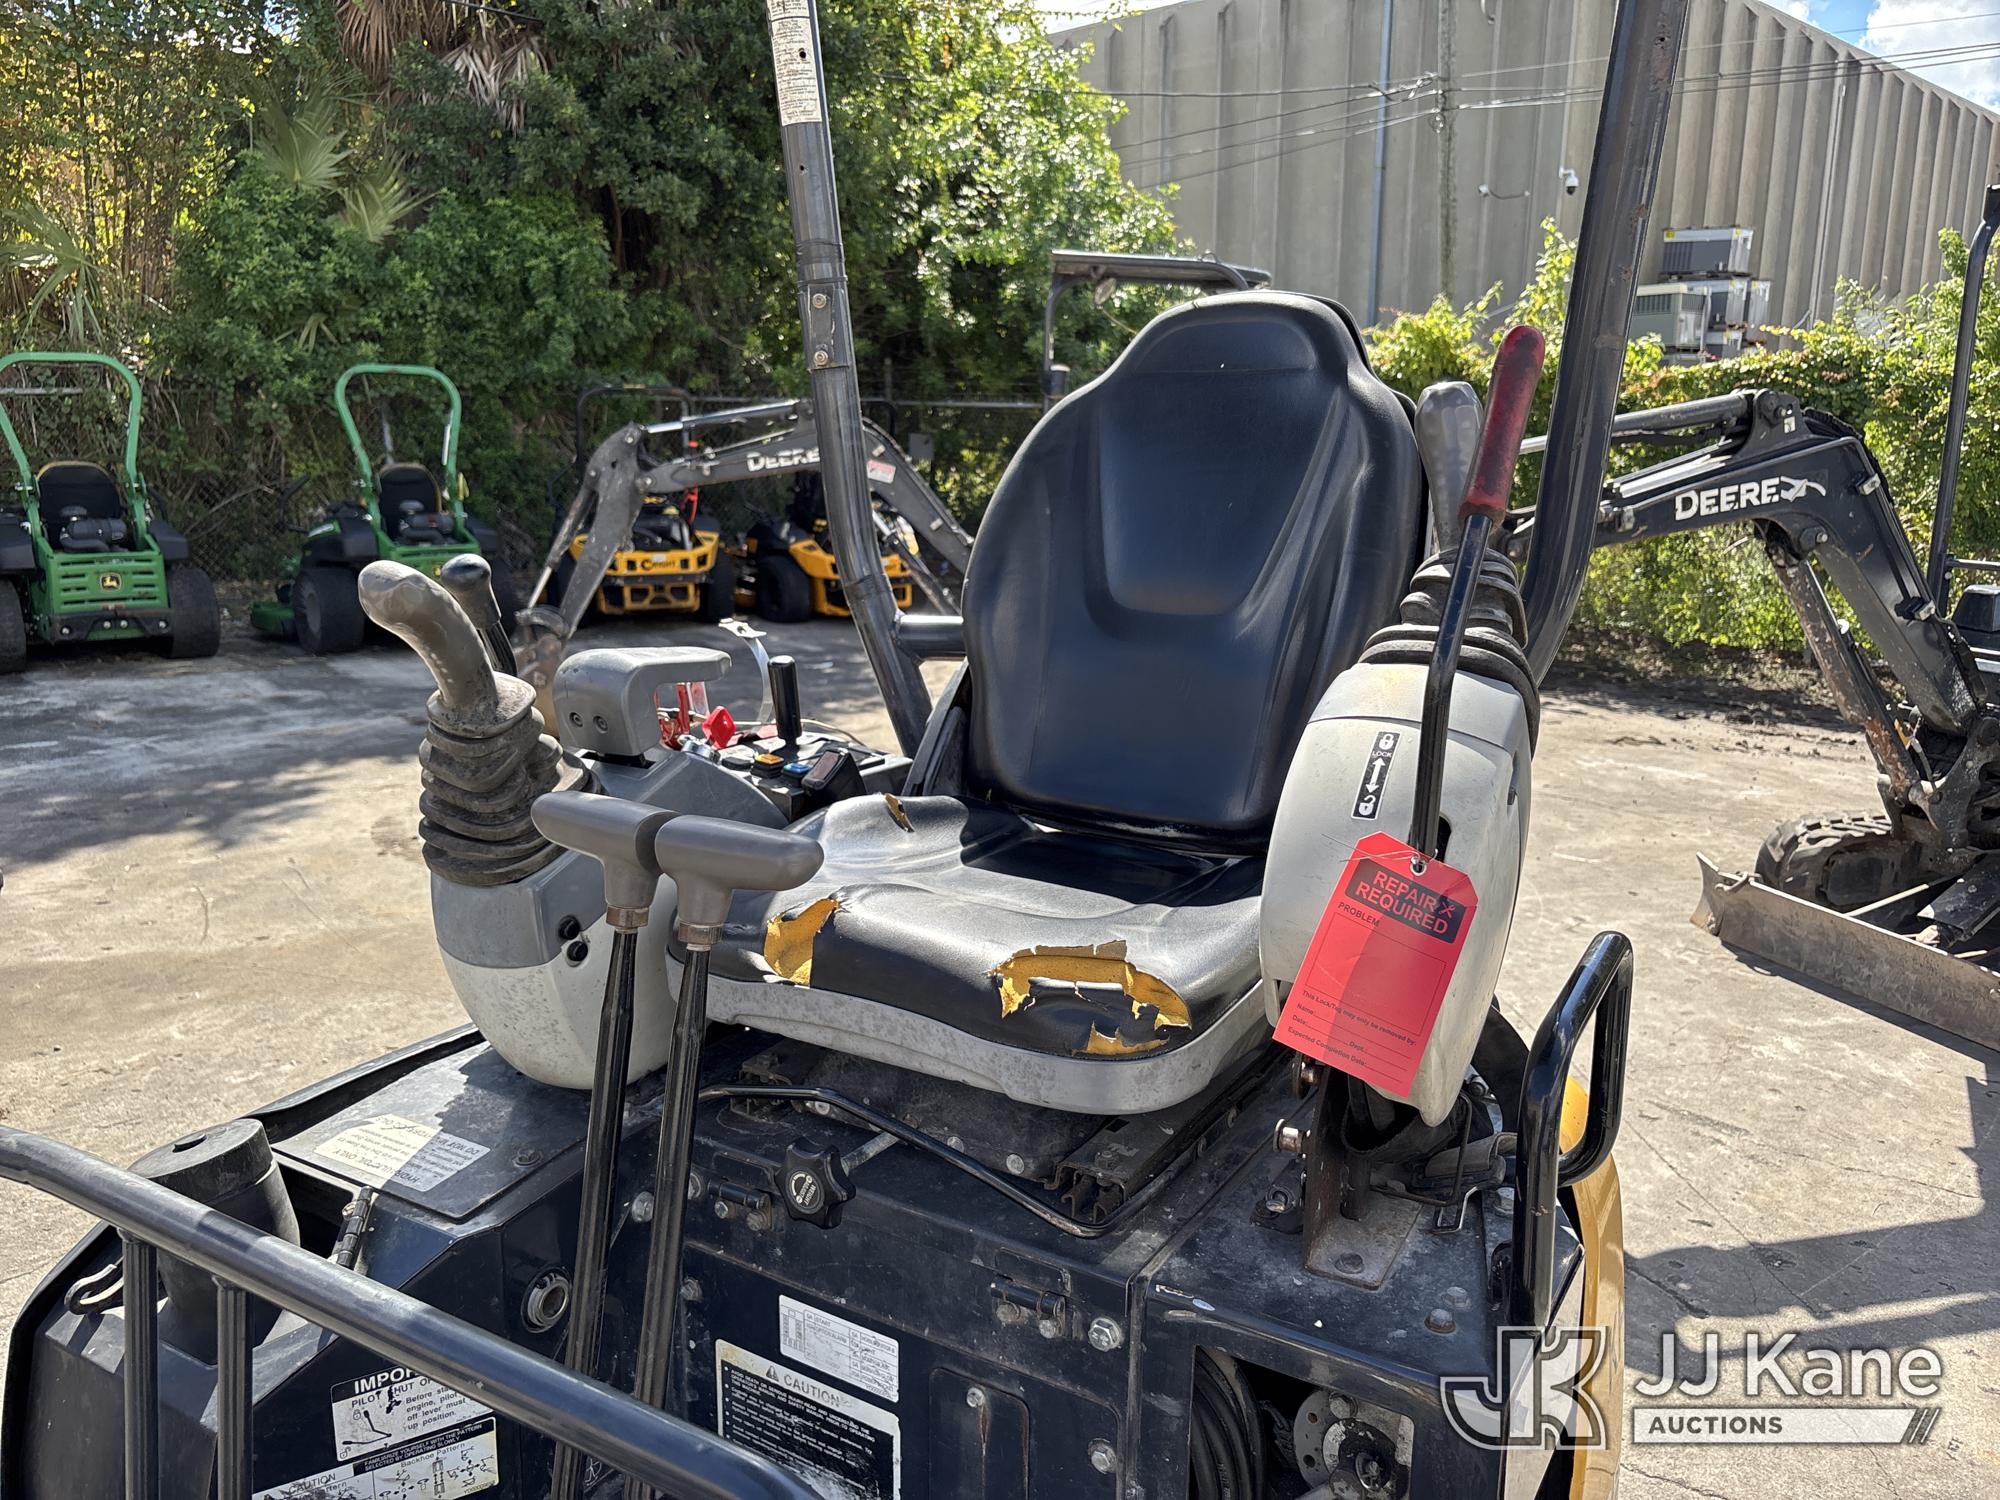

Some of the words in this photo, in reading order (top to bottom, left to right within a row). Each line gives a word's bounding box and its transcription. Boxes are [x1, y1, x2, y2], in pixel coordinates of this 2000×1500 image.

[747, 448, 820, 472] DEERE
[1675, 477, 1780, 521] DEERE
[1372, 750, 1392, 758] LOCK
[1372, 870, 1437, 913] REPAIR
[1338, 902, 1380, 927] PROBLEM
[1355, 881, 1448, 934] REQUIRED
[1303, 989, 1315, 1000] This
[1343, 1009, 1356, 1020] may
[1356, 1016, 1370, 1026] only
[1379, 1026, 1406, 1041] removed
[1288, 1026, 1315, 1043] Expected
[1315, 1040, 1350, 1059] Completion
[351, 1390, 382, 1408] PILOT
[389, 1382, 414, 1396] HUT
[406, 1391, 432, 1404] Before
[406, 1400, 436, 1413] engine,
[440, 1392, 458, 1404] pilot
[783, 1374, 840, 1407] CAUTION
[407, 1412, 418, 1421] off
[422, 1406, 441, 1416] lever
[446, 1398, 466, 1409] must
[744, 1375, 758, 1385] DEATH
[768, 1385, 787, 1398] SERIOUS
[818, 1408, 827, 1416] AND
[860, 1426, 869, 1434] THE
[777, 1394, 787, 1402] AND
[788, 1399, 804, 1410] SAFETY
[825, 1416, 839, 1426] PRIOR
[848, 1426, 875, 1442] OPERATING
[408, 1422, 418, 1431] up
[422, 1410, 456, 1427] position.
[400, 1440, 429, 1455] YOURSELF
[430, 1435, 444, 1445] WITH
[445, 1431, 455, 1440] THE
[456, 1422, 481, 1436] PATTERN
[364, 1457, 394, 1471] SELECTED
[404, 1443, 436, 1458] OPERATING
[400, 1451, 434, 1468] Backhoe
[436, 1441, 465, 1456] Pattern
[288, 1472, 337, 1495] CAUTION
